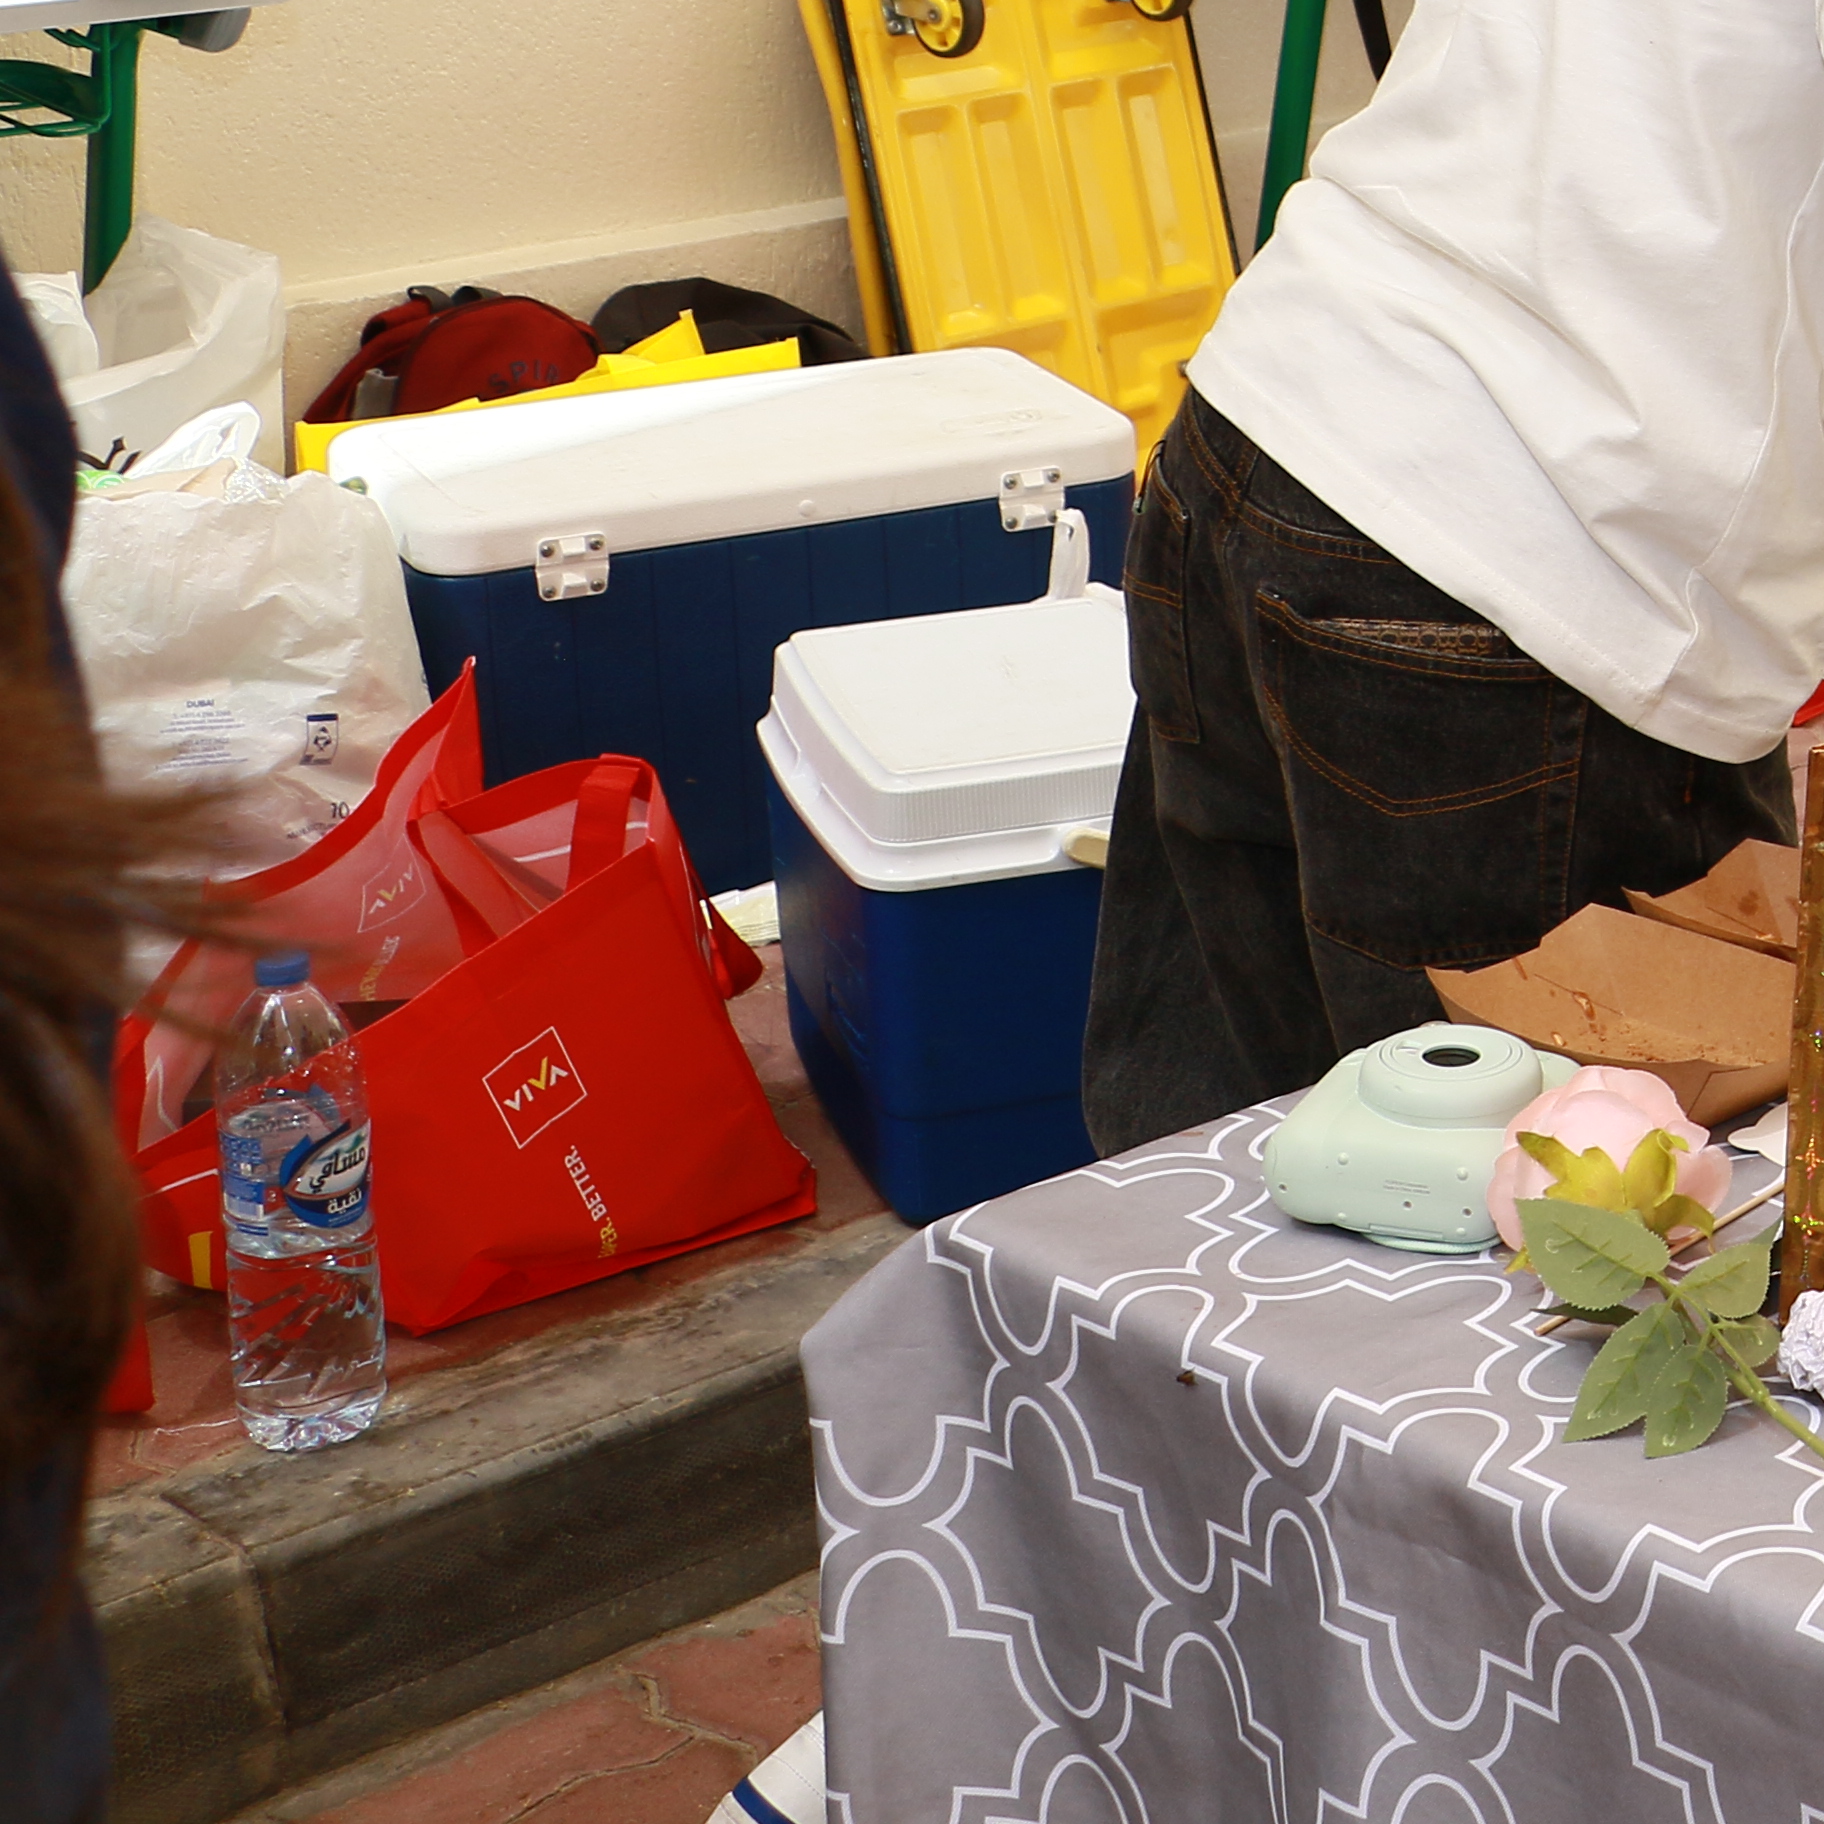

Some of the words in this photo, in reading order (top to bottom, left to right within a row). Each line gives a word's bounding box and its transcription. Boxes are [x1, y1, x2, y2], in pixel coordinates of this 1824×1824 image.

[186, 699, 214, 708] DUBAI
[503, 1056, 569, 1112] VIVA
[564, 1145, 608, 1222] BETTER.
